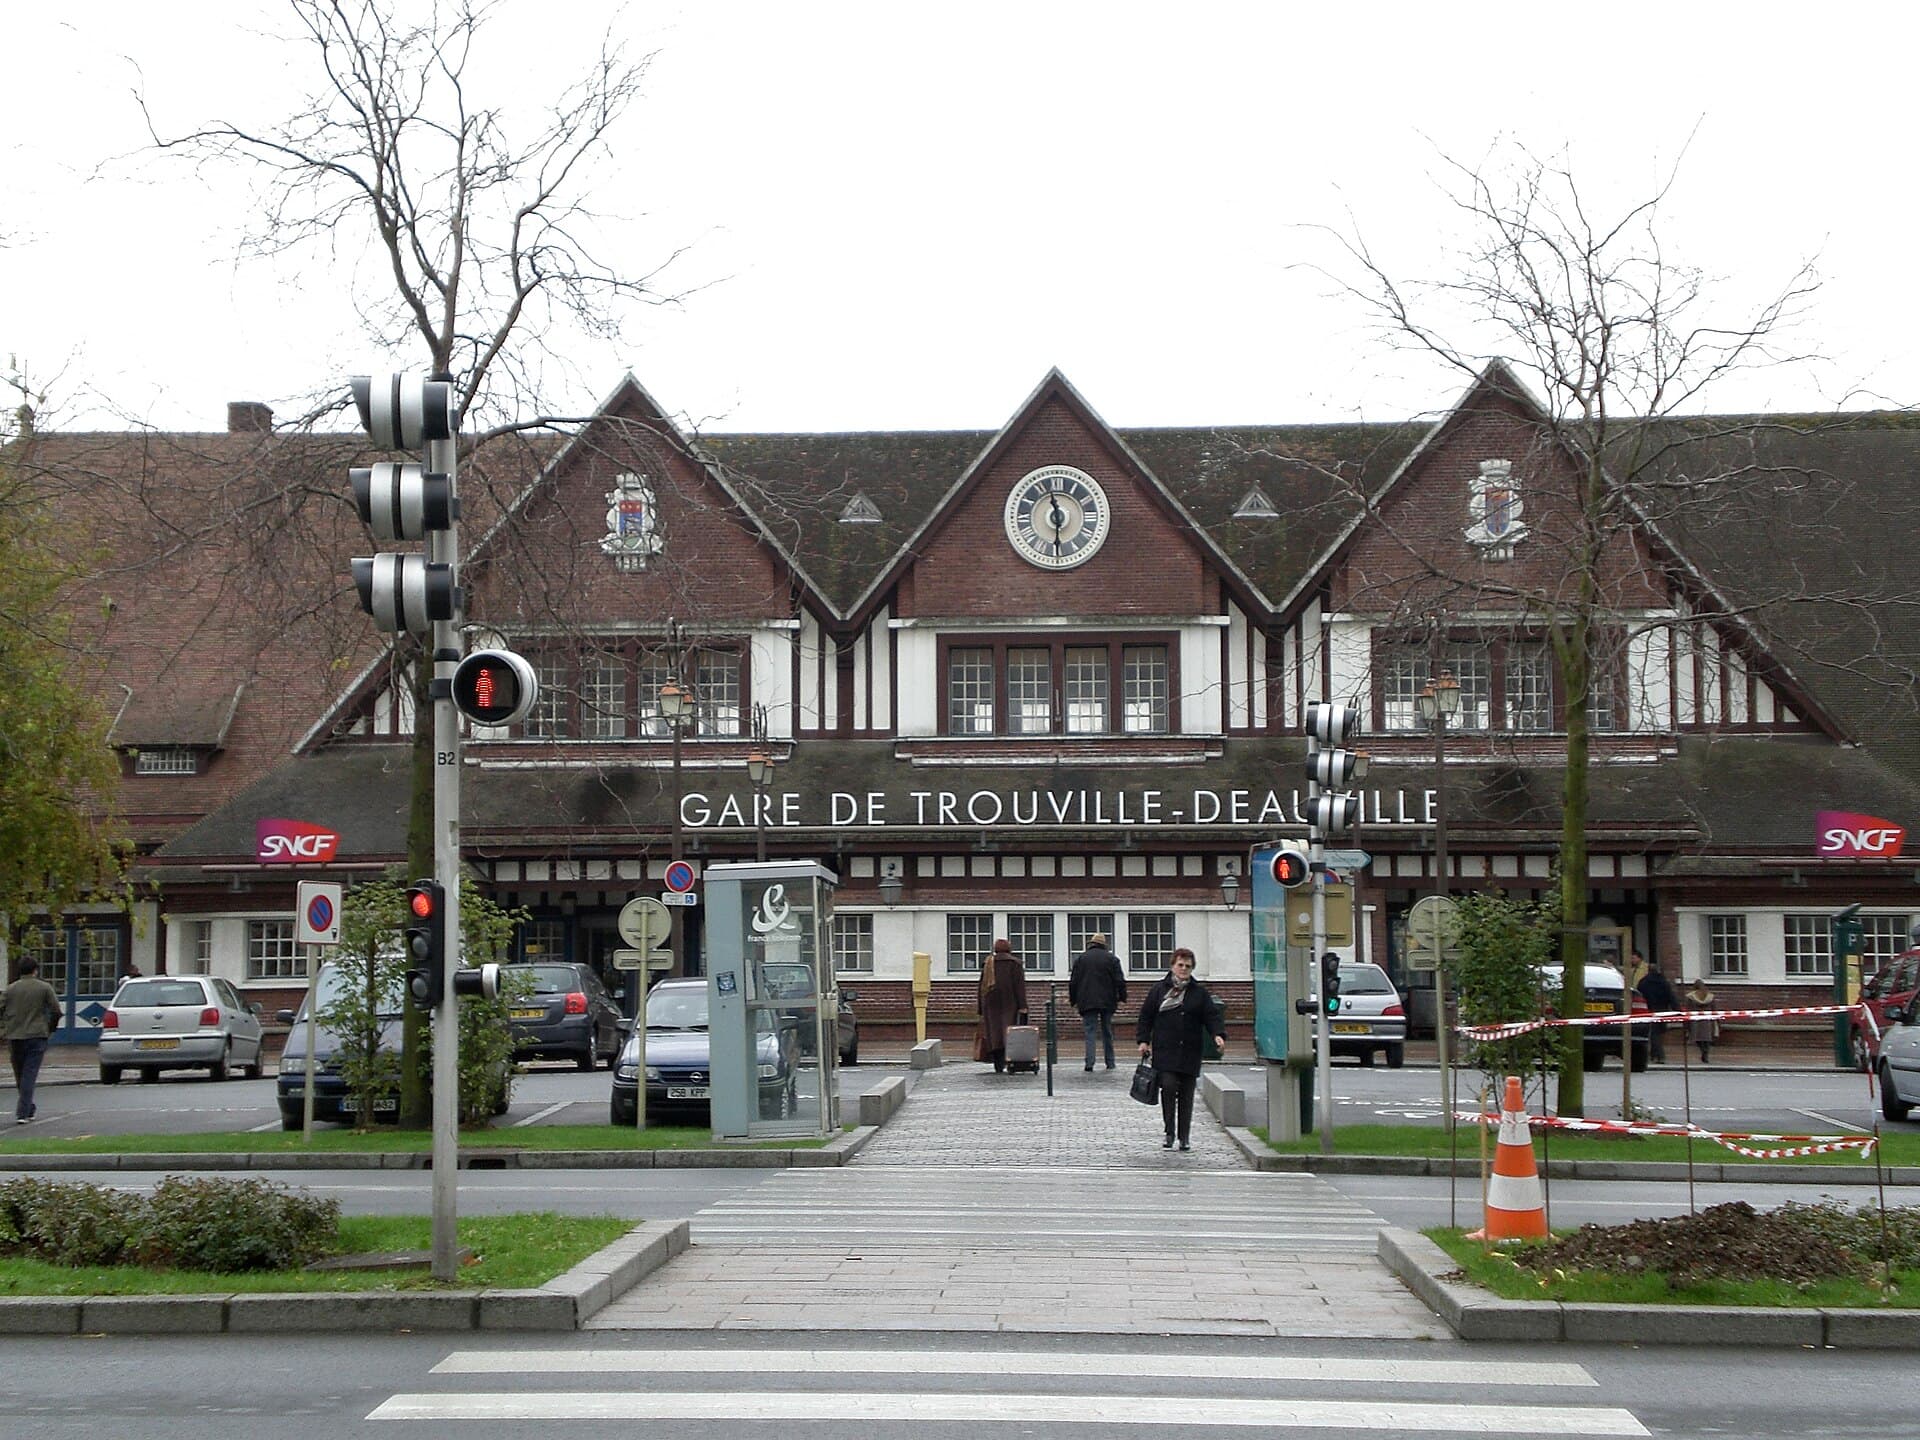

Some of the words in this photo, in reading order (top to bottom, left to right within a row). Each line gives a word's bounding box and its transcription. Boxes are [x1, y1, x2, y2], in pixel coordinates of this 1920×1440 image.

[437, 751, 456, 766] B2
[680, 793, 800, 826] GARE
[831, 792, 885, 826] DE
[910, 790, 1438, 825] TROUVILLE-DEAUILLE
[259, 834, 336, 857] SNCF
[1821, 829, 1901, 851] SNCF
